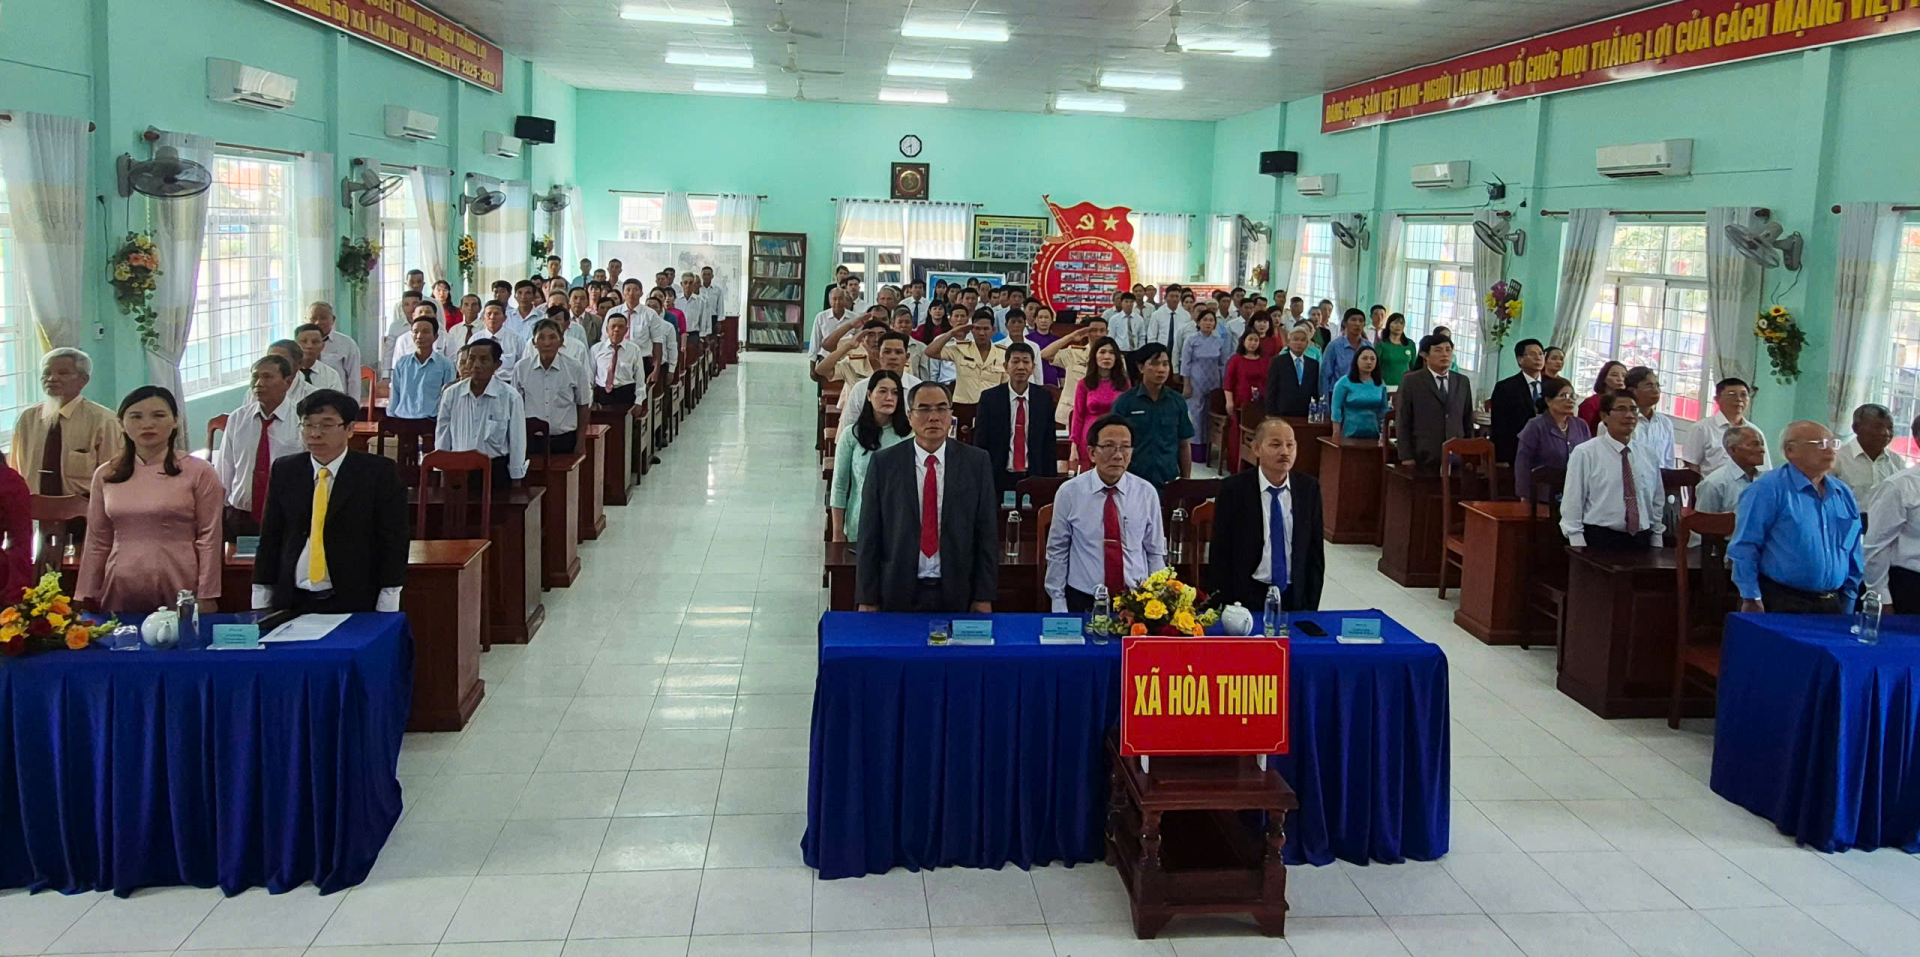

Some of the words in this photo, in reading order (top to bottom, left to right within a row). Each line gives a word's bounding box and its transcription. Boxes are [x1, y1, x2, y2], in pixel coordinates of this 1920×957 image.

[350, 9, 366, 32] XÃ
[1345, 95, 1363, 122] CỘNG
[1364, 87, 1380, 115] SẢN
[1381, 85, 1399, 114] VIỆT
[1509, 47, 1525, 87] TỔ
[1525, 46, 1560, 83] CHỨC
[1561, 44, 1589, 79] MỌI
[1591, 25, 1644, 70] THẮNG
[1645, 22, 1674, 64] LỢI
[1675, 9, 1712, 54] CỦA
[1714, 2, 1771, 46] CÁCH
[1772, 0, 1844, 37] MẠNG
[1133, 666, 1162, 716] XÃ
[1168, 664, 1211, 716] HÒA
[1216, 674, 1278, 725] THỊNH
